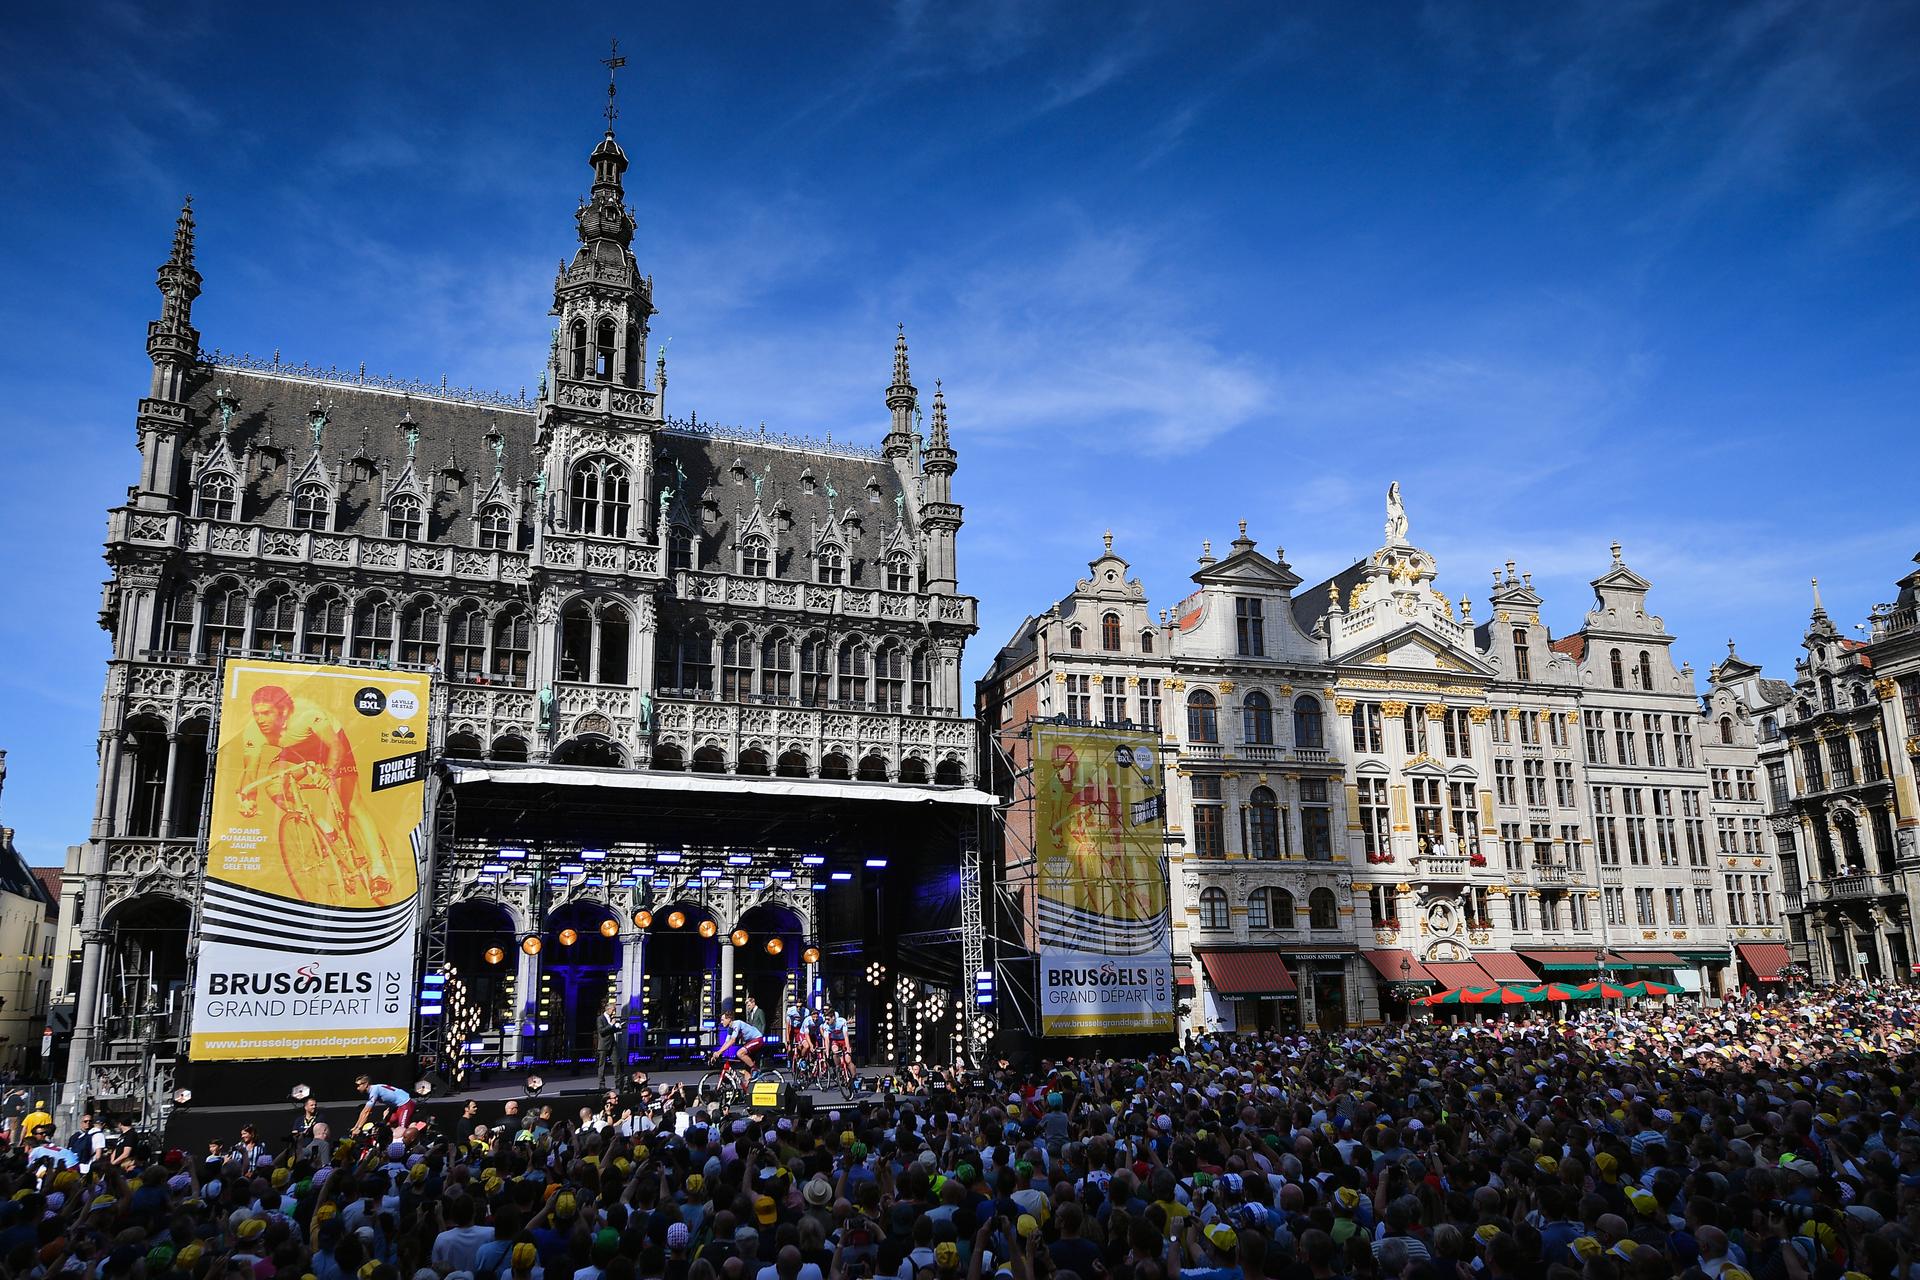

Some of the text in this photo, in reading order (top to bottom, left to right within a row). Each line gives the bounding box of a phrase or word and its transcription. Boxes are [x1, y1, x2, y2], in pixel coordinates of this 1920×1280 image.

[359, 700, 381, 710] BXL
[379, 756, 417, 775] TOUR DE
[1117, 755, 1132, 763] BXL
[379, 767, 416, 786] FRANCE
[1134, 798, 1158, 813] TOUR DE
[1135, 807, 1158, 823] FRANCE
[209, 972, 372, 995] BRUSSELS
[1048, 968, 1148, 987] BRUSSELS
[1154, 968, 1166, 1002] 2019
[384, 971, 401, 1014] 2019
[1049, 987, 1148, 1004] GRAND DÉPART
[207, 995, 371, 1018] GRAND DÉPART
[1051, 1017, 1168, 1029] www.brusselsgranddepart.com
[205, 1035, 396, 1049] www.brusselsgranddepart.com
